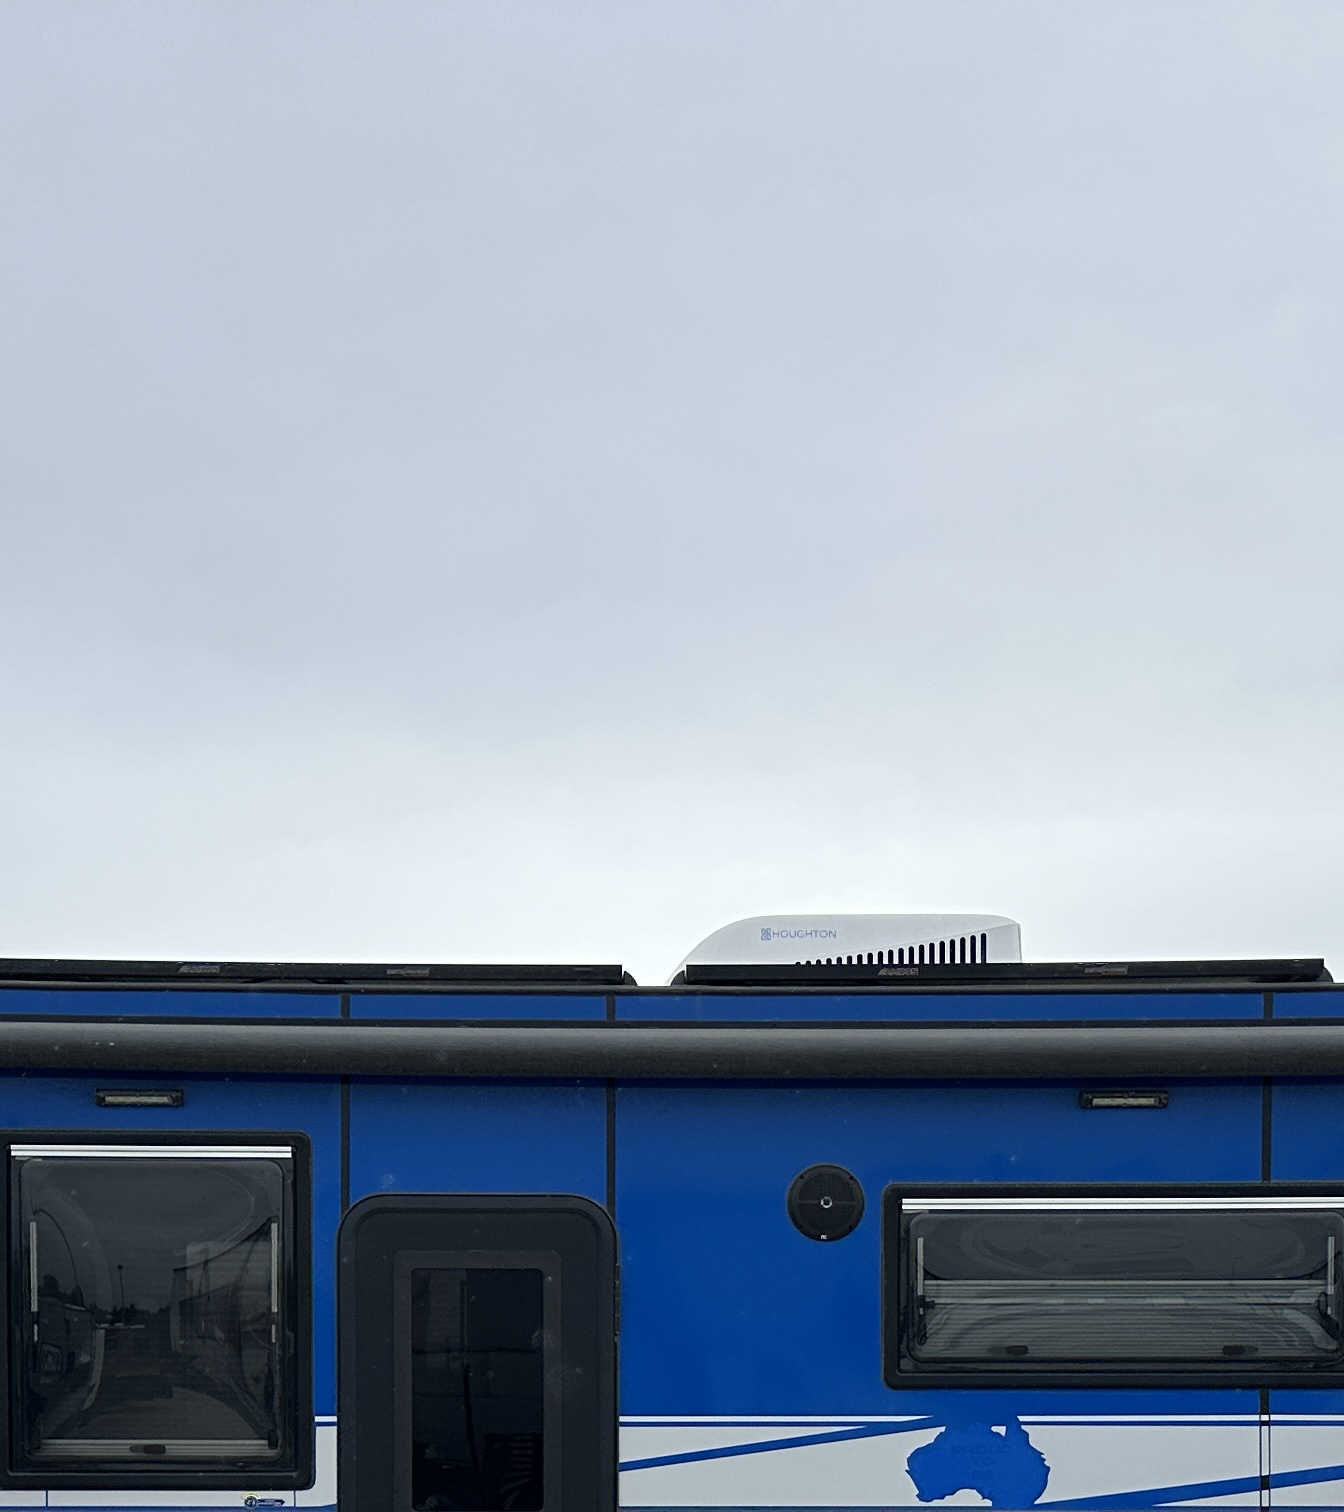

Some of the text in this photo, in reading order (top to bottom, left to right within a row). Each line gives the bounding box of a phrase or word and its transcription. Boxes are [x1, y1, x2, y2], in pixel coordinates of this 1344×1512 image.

[772, 929, 837, 939] HOUGHTON
[951, 1444, 1012, 1455] PROUD
[971, 1456, 994, 1466] TO
[971, 1470, 993, 1480] BE
